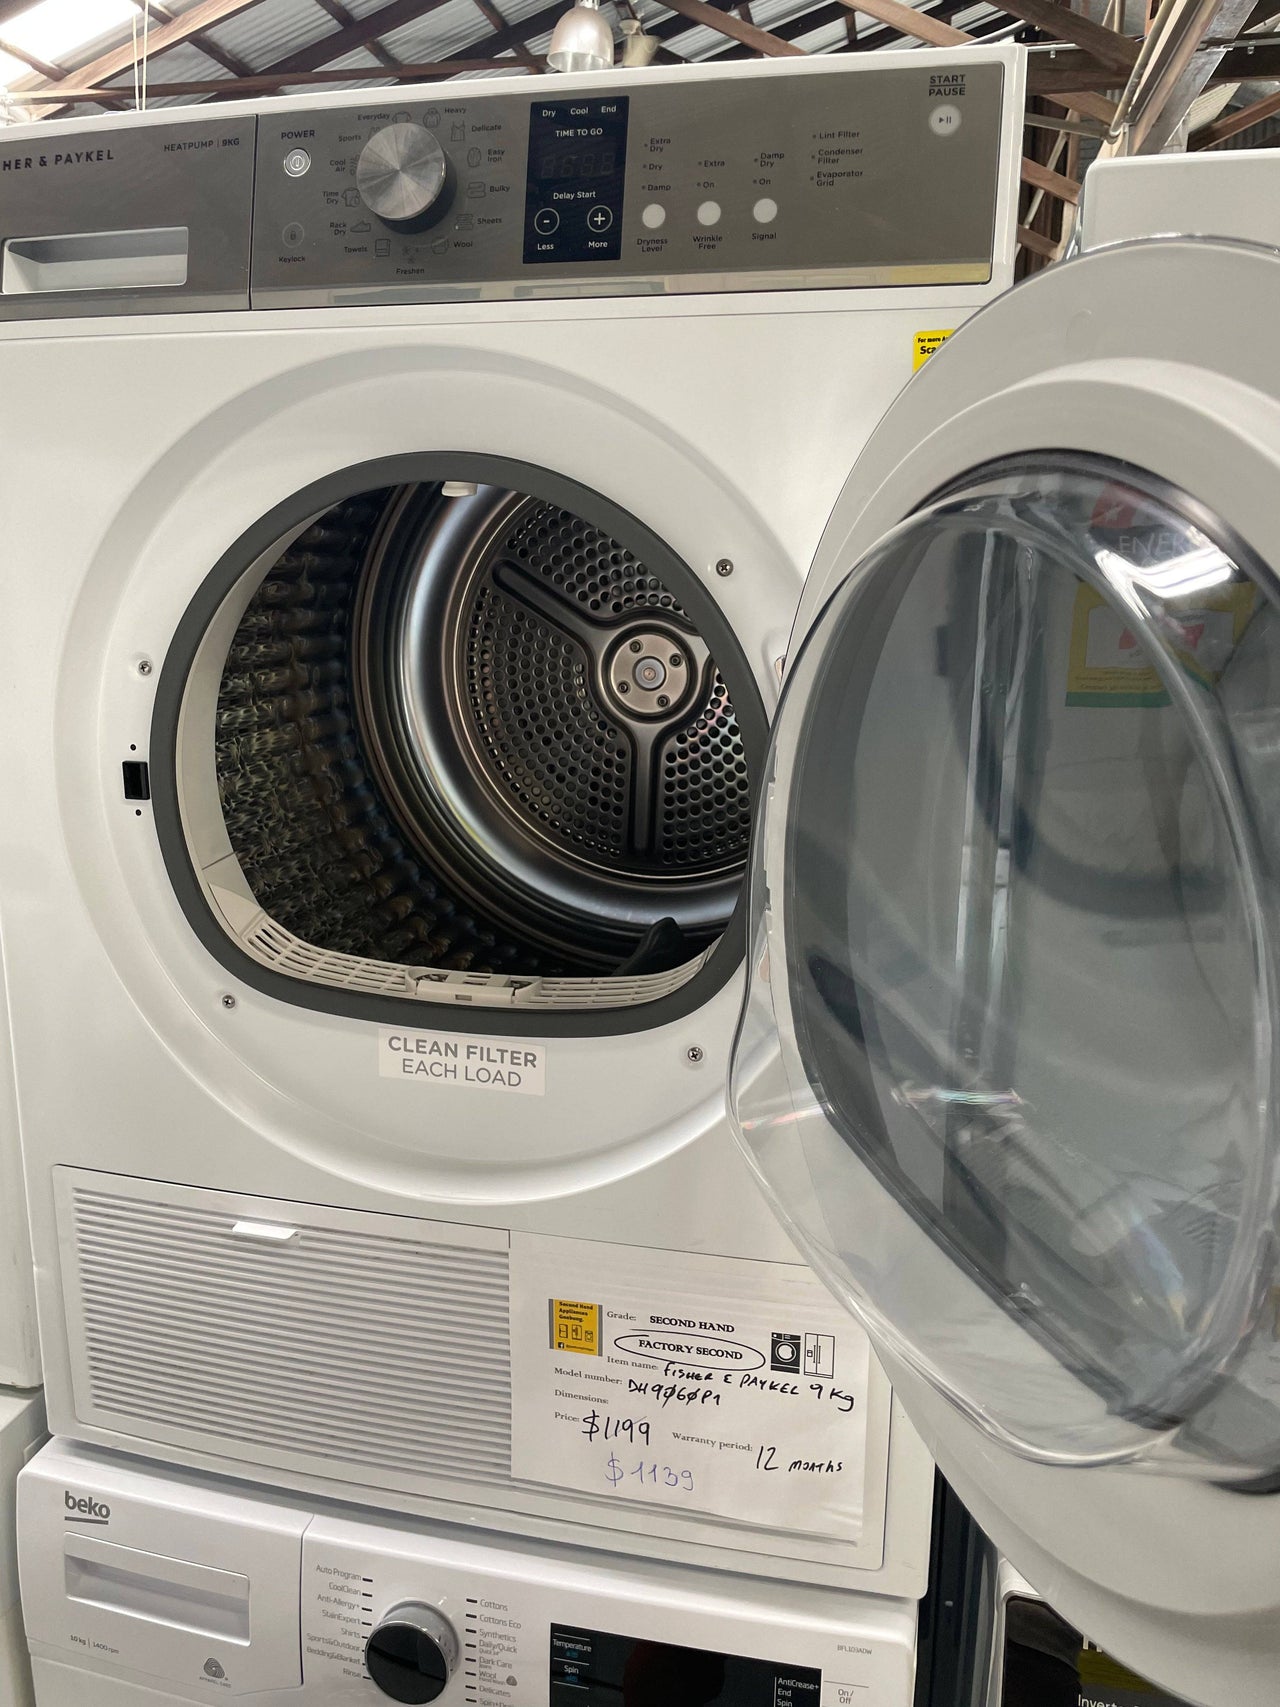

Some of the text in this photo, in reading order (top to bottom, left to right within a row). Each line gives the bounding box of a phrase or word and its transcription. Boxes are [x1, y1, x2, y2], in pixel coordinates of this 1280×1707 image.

[930, 74, 966, 84] START
[929, 87, 966, 97] PAUSE
[444, 107, 466, 115] Heavy
[542, 105, 617, 118] Dry Cool End
[357, 112, 390, 122] Everyday
[471, 123, 502, 133] Delicate
[555, 127, 603, 138] TIME TO GO
[281, 130, 316, 140] POWER
[338, 134, 361, 143] Sports
[818, 131, 860, 140] Lint Filter
[163, 138, 240, 152] HEATPUMP 9KG
[649, 144, 664, 153] Dry
[487, 148, 505, 156] Easy
[760, 152, 785, 160] Damp
[818, 148, 863, 157] Condenser
[39, 156, 48, 168] &
[54, 149, 115, 166] PAYKEL
[329, 159, 346, 167] Cool
[817, 157, 840, 165] Filter
[649, 163, 662, 171] Dry
[704, 160, 725, 168] Extra
[760, 160, 775, 169] Dry
[335, 165, 346, 173] Air
[817, 170, 863, 179] Evaporator
[703, 181, 715, 189] On
[759, 178, 771, 186] On
[816, 179, 835, 187] Grid
[489, 184, 510, 193] Bulky
[647, 184, 671, 193] Damp
[322, 190, 339, 198] Time
[553, 190, 596, 201] Delay Start
[326, 197, 339, 205] Dry
[476, 216, 502, 225] Sheets
[329, 222, 347, 230] Rack
[334, 228, 347, 236] Dry
[637, 237, 668, 247] Dryness
[693, 235, 723, 243] Wrinkle
[751, 233, 777, 242] Signal
[537, 243, 554, 251] Less
[588, 240, 608, 248] More
[344, 245, 368, 253] Towels
[278, 255, 305, 264] Keylock
[396, 267, 425, 275] Freshen
[388, 1036, 537, 1069] CLEAN FILTER
[402, 1058, 521, 1087] EACH LOAD
[607, 1311, 637, 1321] Grade:
[650, 1315, 735, 1334] SECOND HAND
[638, 1339, 744, 1361] FACTORY SECOND
[607, 1356, 659, 1370] Item name:
[554, 1367, 623, 1385] Model number:
[739, 1374, 800, 1396] PAYKEL
[809, 1383, 824, 1400] 9
[554, 1389, 609, 1405] Dimensions:
[554, 1411, 580, 1422] Price:
[582, 1409, 650, 1446] $1199
[672, 1432, 753, 1451] Warranty period:
[756, 1445, 779, 1471] 12
[65, 1490, 110, 1519] beko
[316, 1564, 362, 1580] Auto Program
[480, 1599, 508, 1612] Cottons
[479, 1614, 522, 1629] Cottons Eco
[479, 1629, 517, 1643] Synthetics
[553, 1638, 592, 1652] Temperature
[563, 1664, 579, 1674] Spin
[778, 1688, 792, 1697] End
[838, 1688, 849, 1697] On
[839, 1696, 851, 1704] Off
